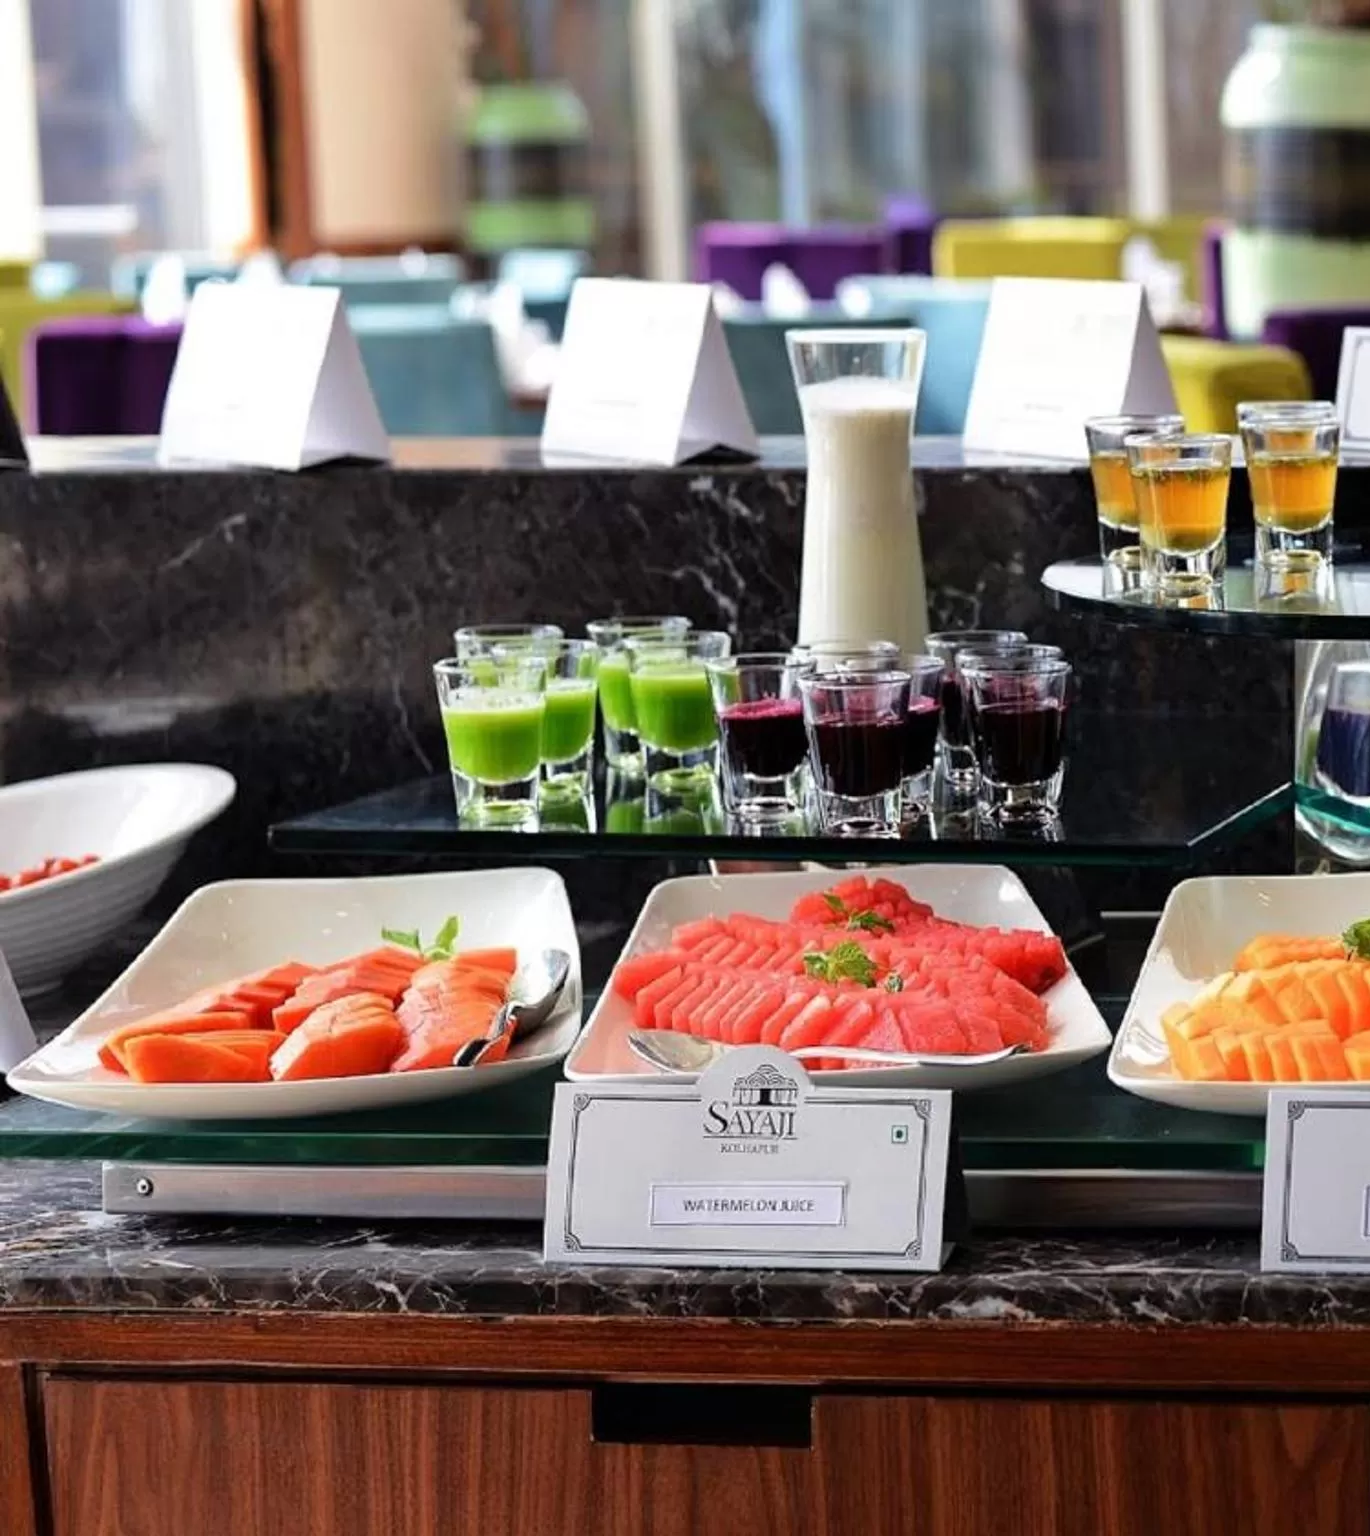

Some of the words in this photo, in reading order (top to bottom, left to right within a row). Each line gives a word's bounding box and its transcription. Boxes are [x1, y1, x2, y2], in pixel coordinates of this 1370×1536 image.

[703, 1101, 797, 1140] SAYAJI
[682, 1199, 778, 1213] WATERMELON
[779, 1199, 815, 1213] JUICE
